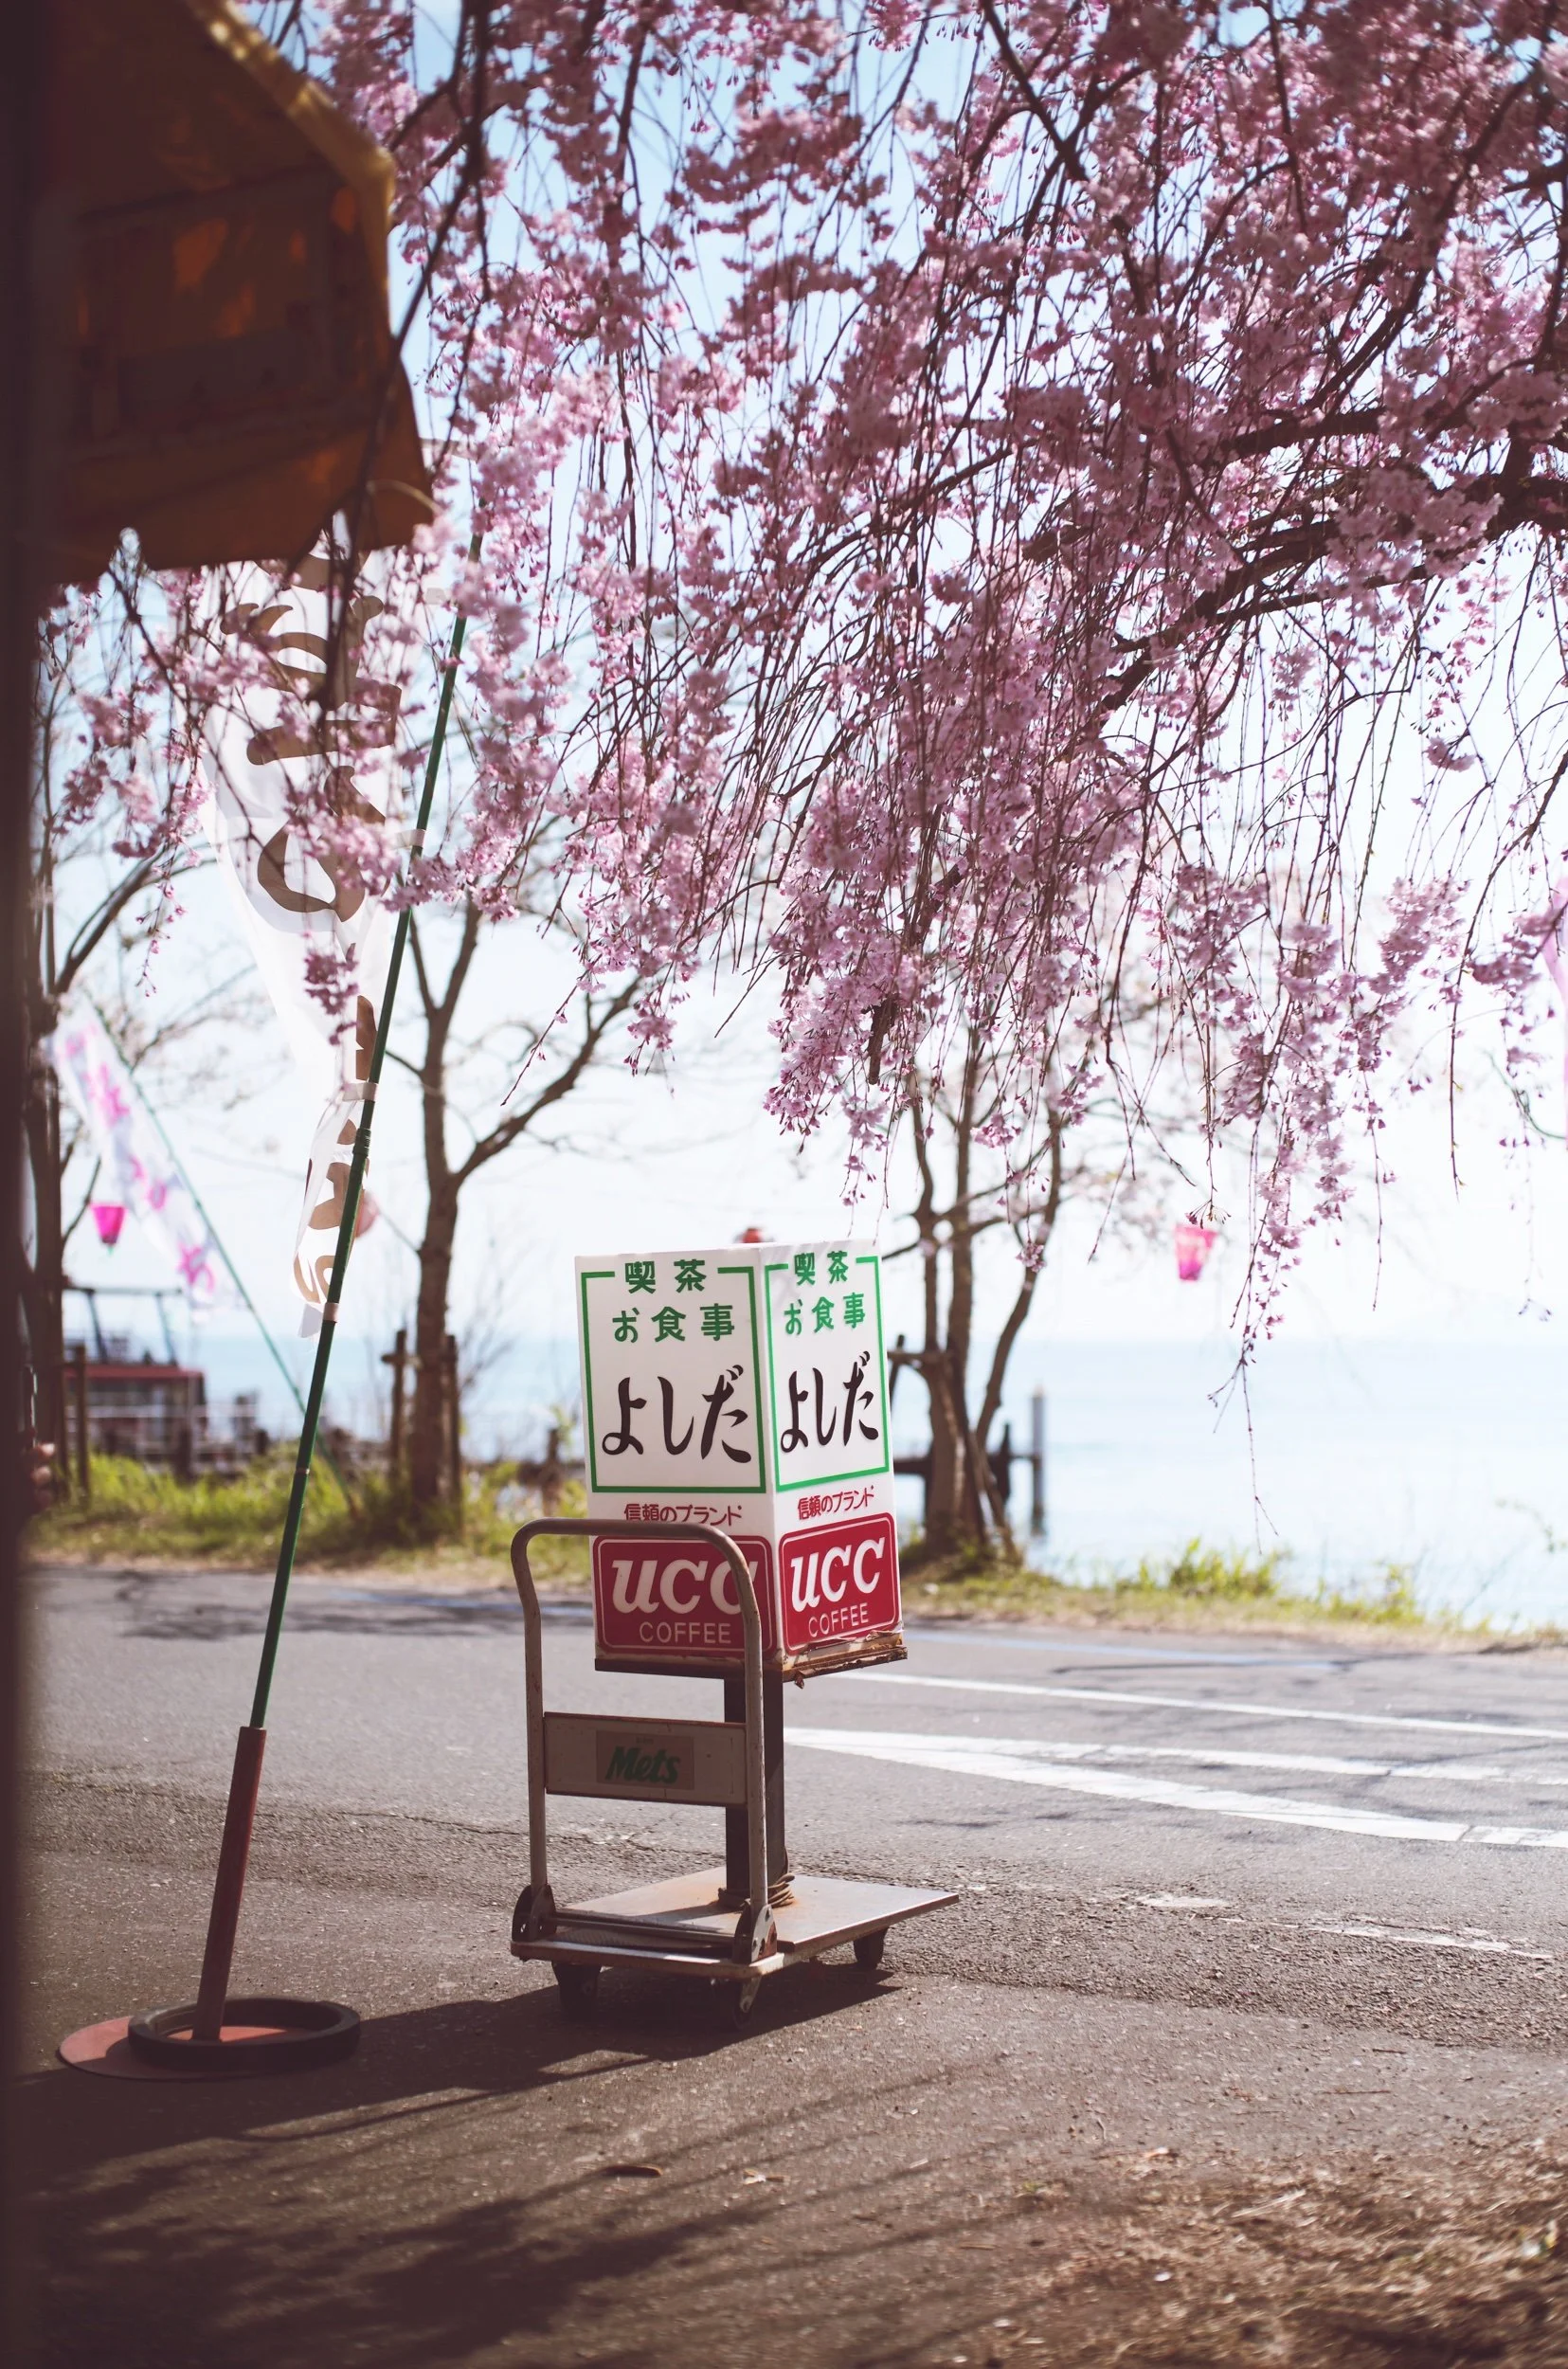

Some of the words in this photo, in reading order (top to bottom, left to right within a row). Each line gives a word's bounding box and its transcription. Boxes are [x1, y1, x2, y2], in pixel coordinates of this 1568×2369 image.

[624, 1259, 707, 1294] 喫茶
[794, 1250, 849, 1287] 喫茶
[612, 1303, 735, 1343] お食事
[784, 1292, 866, 1337] お食事
[602, 1364, 752, 1464] よしだ
[780, 1350, 879, 1454] よしだ
[623, 1503, 742, 1527] 信頼のブランド
[797, 1485, 875, 1521] 信頼のブランド
[611, 1559, 759, 1615] UCC
[790, 1536, 886, 1613] UCC
[639, 1620, 731, 1644] COFFEE
[808, 1601, 869, 1638] COFFEE
[604, 1745, 681, 1784] Mets
